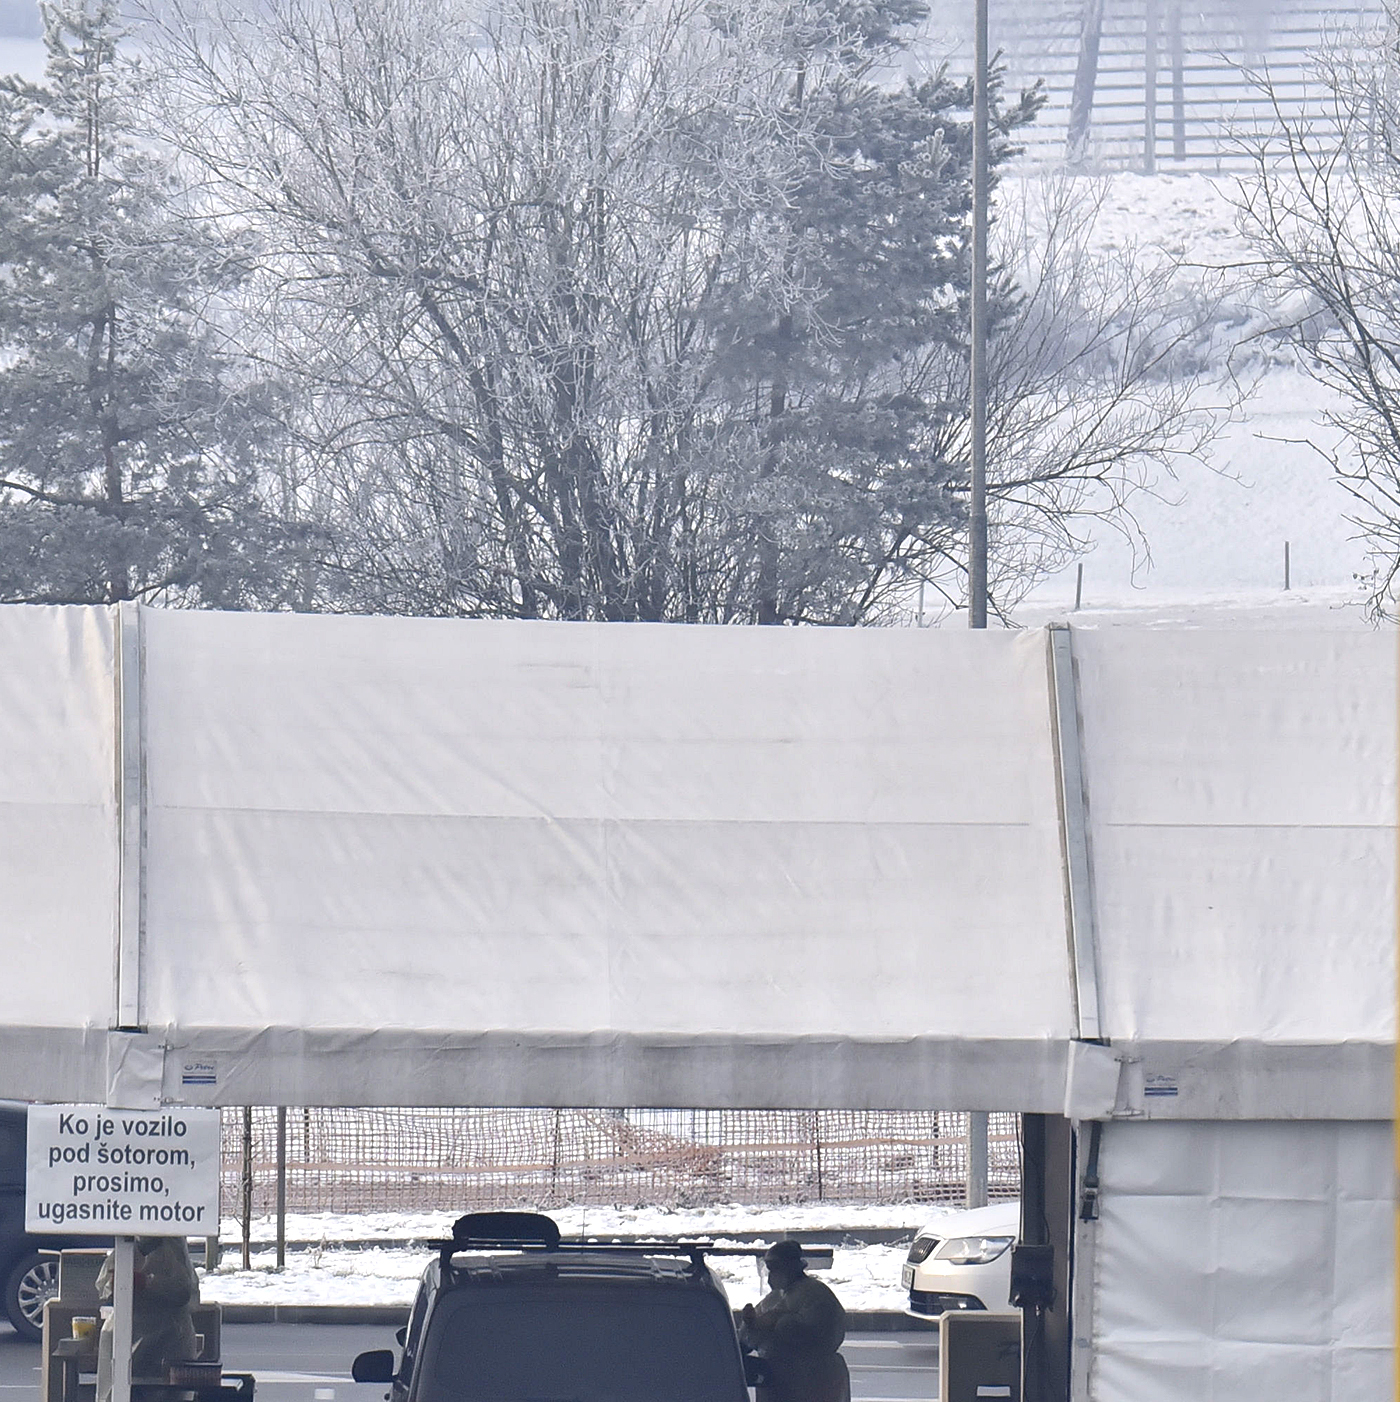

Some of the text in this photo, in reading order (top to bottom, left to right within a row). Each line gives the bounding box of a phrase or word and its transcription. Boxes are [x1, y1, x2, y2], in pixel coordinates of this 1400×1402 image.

[59, 1113, 187, 1141] Ko je vozilo
[48, 1142, 196, 1169] pod šotorom,
[73, 1172, 170, 1197] prosimo,
[38, 1199, 205, 1224] ugasnite motor
